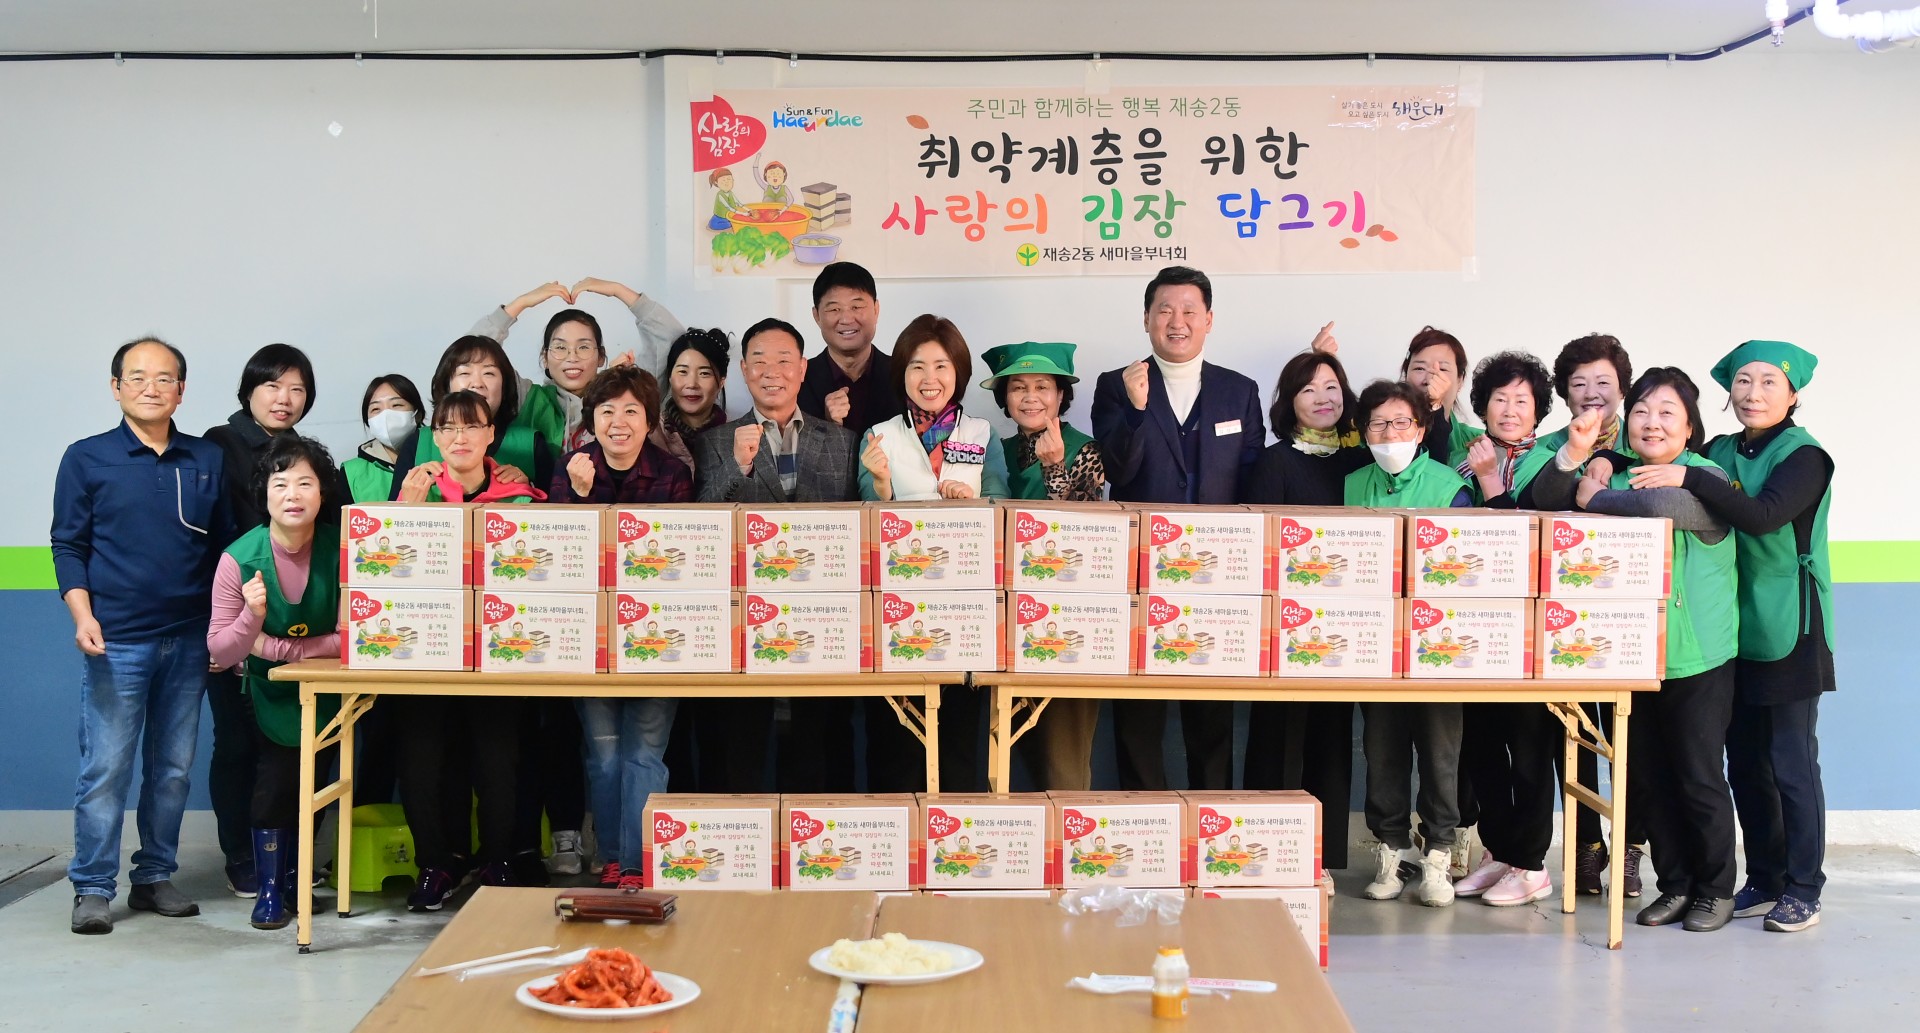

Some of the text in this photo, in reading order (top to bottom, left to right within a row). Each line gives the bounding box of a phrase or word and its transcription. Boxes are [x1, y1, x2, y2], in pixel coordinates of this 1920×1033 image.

[967, 96, 1242, 119] 주민과 함께하는 행복 재송2동
[1370, 101, 1383, 109] 도시
[786, 106, 833, 116] Sun & Fun
[1392, 101, 1444, 120] 해운대
[697, 111, 751, 138] 사랑의
[701, 135, 740, 157] 김장
[917, 126, 1310, 185] 취약계층을 위한
[881, 187, 1366, 242] 사랑의 김장 담그기
[1043, 246, 1187, 261] 재송2동 새마을부녀회
[351, 516, 375, 526] 사랑의
[393, 520, 414, 528] 재송2동
[415, 520, 451, 528] 새마을부녀회
[487, 519, 511, 530] 사랑의
[620, 519, 643, 530] 사랑의
[748, 520, 772, 531] 사랑의
[882, 518, 906, 529] 사랑의
[925, 521, 946, 529] 재송2동
[946, 521, 982, 529] 새마을부녀회
[1018, 519, 1042, 530] 사랑의
[352, 525, 370, 534] 김장
[529, 523, 550, 531] 재송2동
[662, 523, 683, 531] 재송2동
[684, 523, 719, 531] 새마을부녀회
[791, 524, 812, 532] 재송2동
[812, 523, 848, 531] 새마을부녀회
[1060, 524, 1117, 533] 재송2동 새마을부녀회
[1152, 522, 1176, 533] 사랑의
[1195, 526, 1215, 534] 재송2동
[1216, 526, 1251, 534] 새마을부녀회
[1282, 525, 1306, 536] 사랑의
[1418, 525, 1442, 536] 사랑의
[488, 529, 506, 538] 김장
[621, 528, 639, 537] 김장
[749, 530, 768, 539] 김장
[883, 528, 902, 537] 김장
[1018, 528, 1037, 538] 김장
[1153, 532, 1171, 541] 김장
[1325, 529, 1345, 537] 재송2동
[1347, 530, 1381, 538] 새마을부녀회
[1460, 529, 1481, 537] 재송2동
[1482, 529, 1517, 537] 새마을부녀회
[1555, 527, 1578, 538] 사랑의
[1596, 531, 1617, 539] 재송2동
[1618, 531, 1652, 539] 새마을부녀회
[1283, 535, 1301, 544] 김장
[1419, 535, 1437, 544] 김장
[1556, 537, 1574, 546] 김장
[352, 598, 376, 608] 사랑의
[416, 602, 451, 610] 새마을부녀회
[485, 601, 509, 612] 사랑의
[619, 601, 643, 612] 사랑의
[748, 602, 772, 613] 사랑의
[884, 600, 908, 611] 사랑의
[927, 603, 948, 611] 재송2동
[949, 603, 984, 611] 새마을부녀회
[1019, 601, 1043, 612] 사랑의
[353, 607, 371, 616] 김장
[549, 606, 584, 614] 새마을부녀회
[661, 604, 682, 612] 재송2동
[683, 604, 718, 612] 새마을부녀회
[1061, 605, 1082, 613] 재송2동
[1083, 606, 1118, 614] 새마을부녀회
[1150, 603, 1174, 613] 사랑의
[1192, 607, 1213, 615] 재송2동
[1214, 608, 1249, 616] 새마을부녀회
[1283, 606, 1306, 616] 사랑의
[1414, 607, 1437, 617] 사랑의
[486, 610, 504, 620] 김장
[620, 610, 638, 619] 김장
[750, 611, 768, 620] 김장
[885, 609, 904, 618] 김장
[1020, 610, 1038, 619] 김장
[1151, 612, 1169, 621] 김장
[1346, 610, 1381, 618] 새마을부녀회
[1477, 611, 1512, 619] 새마을부녀회
[1547, 608, 1571, 618] 사랑의
[1284, 615, 1302, 624] 김장
[1414, 616, 1432, 625] 김장
[1548, 617, 1566, 626] 김장
[792, 818, 817, 829] 사랑의
[930, 815, 954, 826] 사랑의
[974, 819, 995, 827] 재송2동
[996, 819, 1032, 827] 새마을부녀회
[1065, 816, 1090, 827] 사랑의
[1109, 819, 1130, 827] 재송2동
[1131, 818, 1167, 826] 새마을부녀회
[1201, 814, 1225, 825] 사랑의
[1244, 818, 1265, 826] 재송2동
[1266, 818, 1302, 826] 새마을부녀회
[655, 819, 680, 830] 사랑의
[699, 823, 721, 831] 재송2동
[722, 822, 759, 830] 새마을부녀회
[837, 821, 858, 829] 재송2동
[859, 820, 895, 829] 새마을부녀회
[1202, 824, 1220, 833] 김장
[657, 829, 676, 838] 김장
[794, 827, 813, 837] 김장
[931, 825, 949, 834] 김장
[1066, 825, 1085, 835] 김장
[1277, 848, 1299, 856] 건강하고
[733, 853, 756, 861] 건강하고
